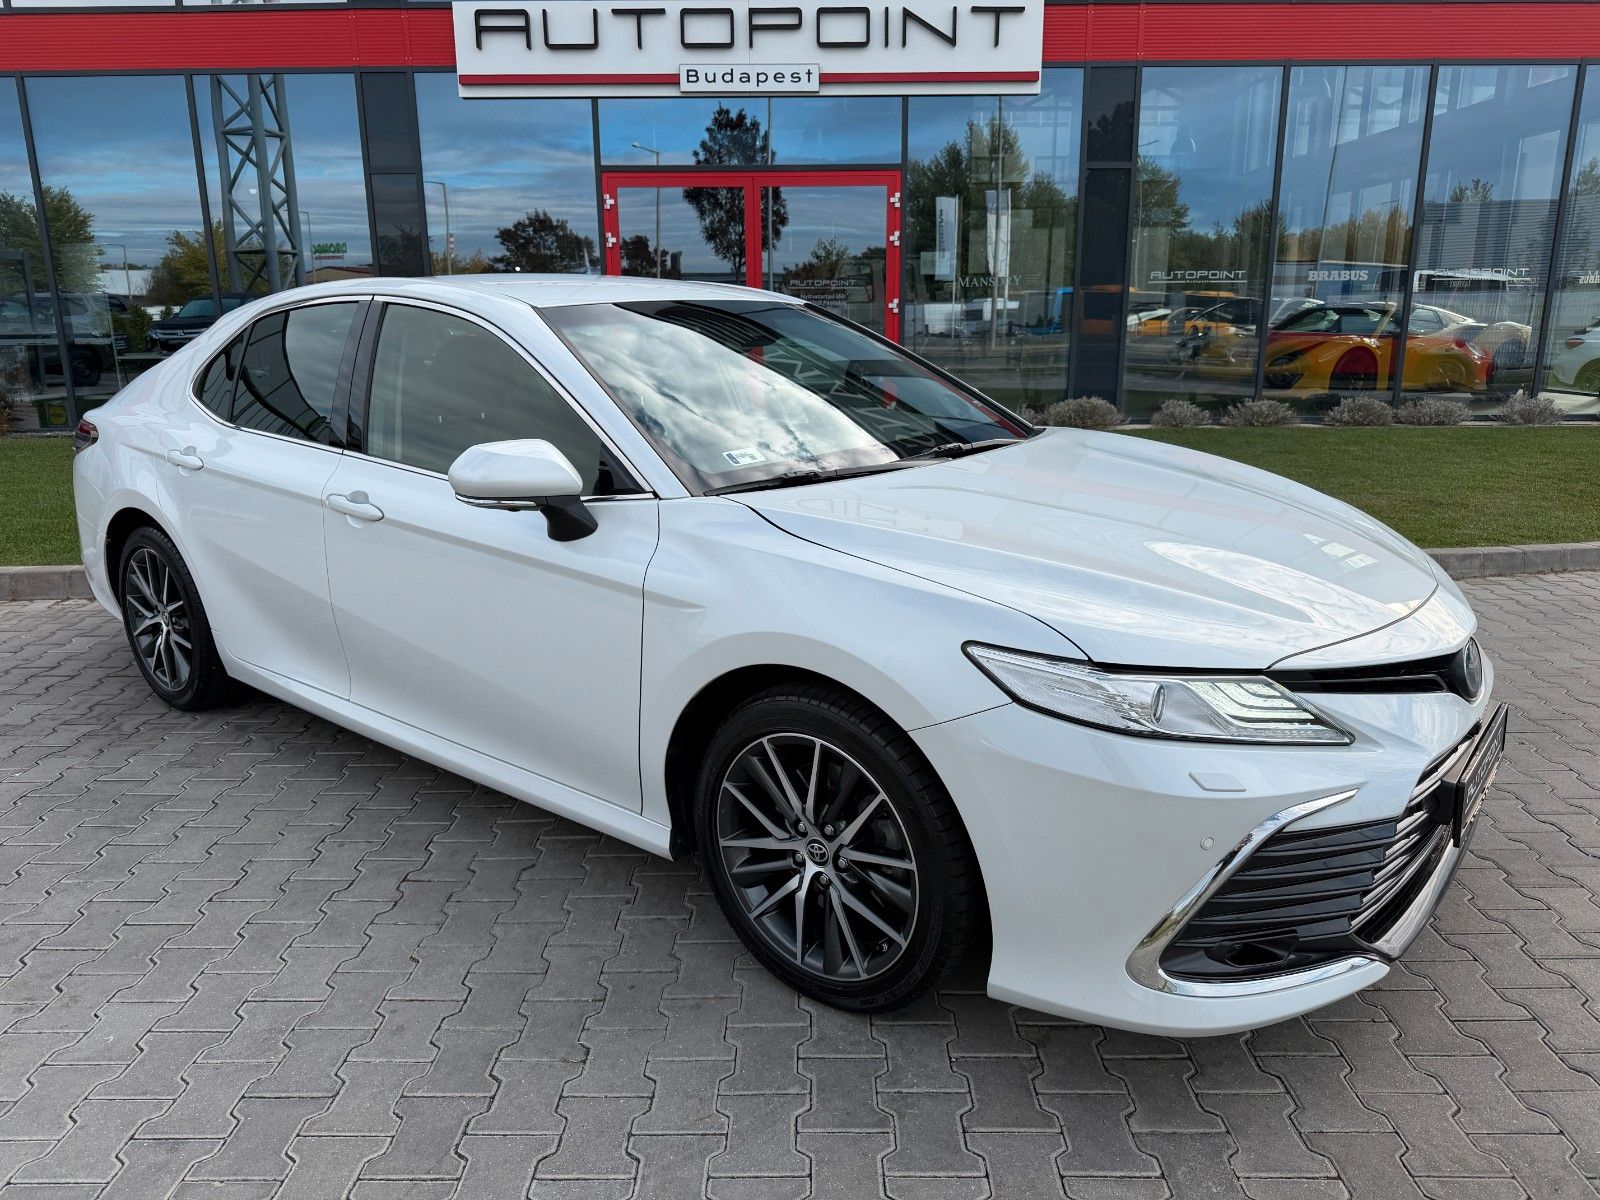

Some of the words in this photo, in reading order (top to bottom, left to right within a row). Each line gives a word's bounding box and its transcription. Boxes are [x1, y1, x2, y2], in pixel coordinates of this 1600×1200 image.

[474, 6, 1026, 51] AUTOPOINT
[685, 67, 814, 88] Budapest
[1149, 270, 1247, 280] AUTOPOINT
[1307, 270, 1369, 281] BRABUS
[789, 279, 857, 287] AUTOPOINT
[958, 275, 1022, 288] MANSORY
